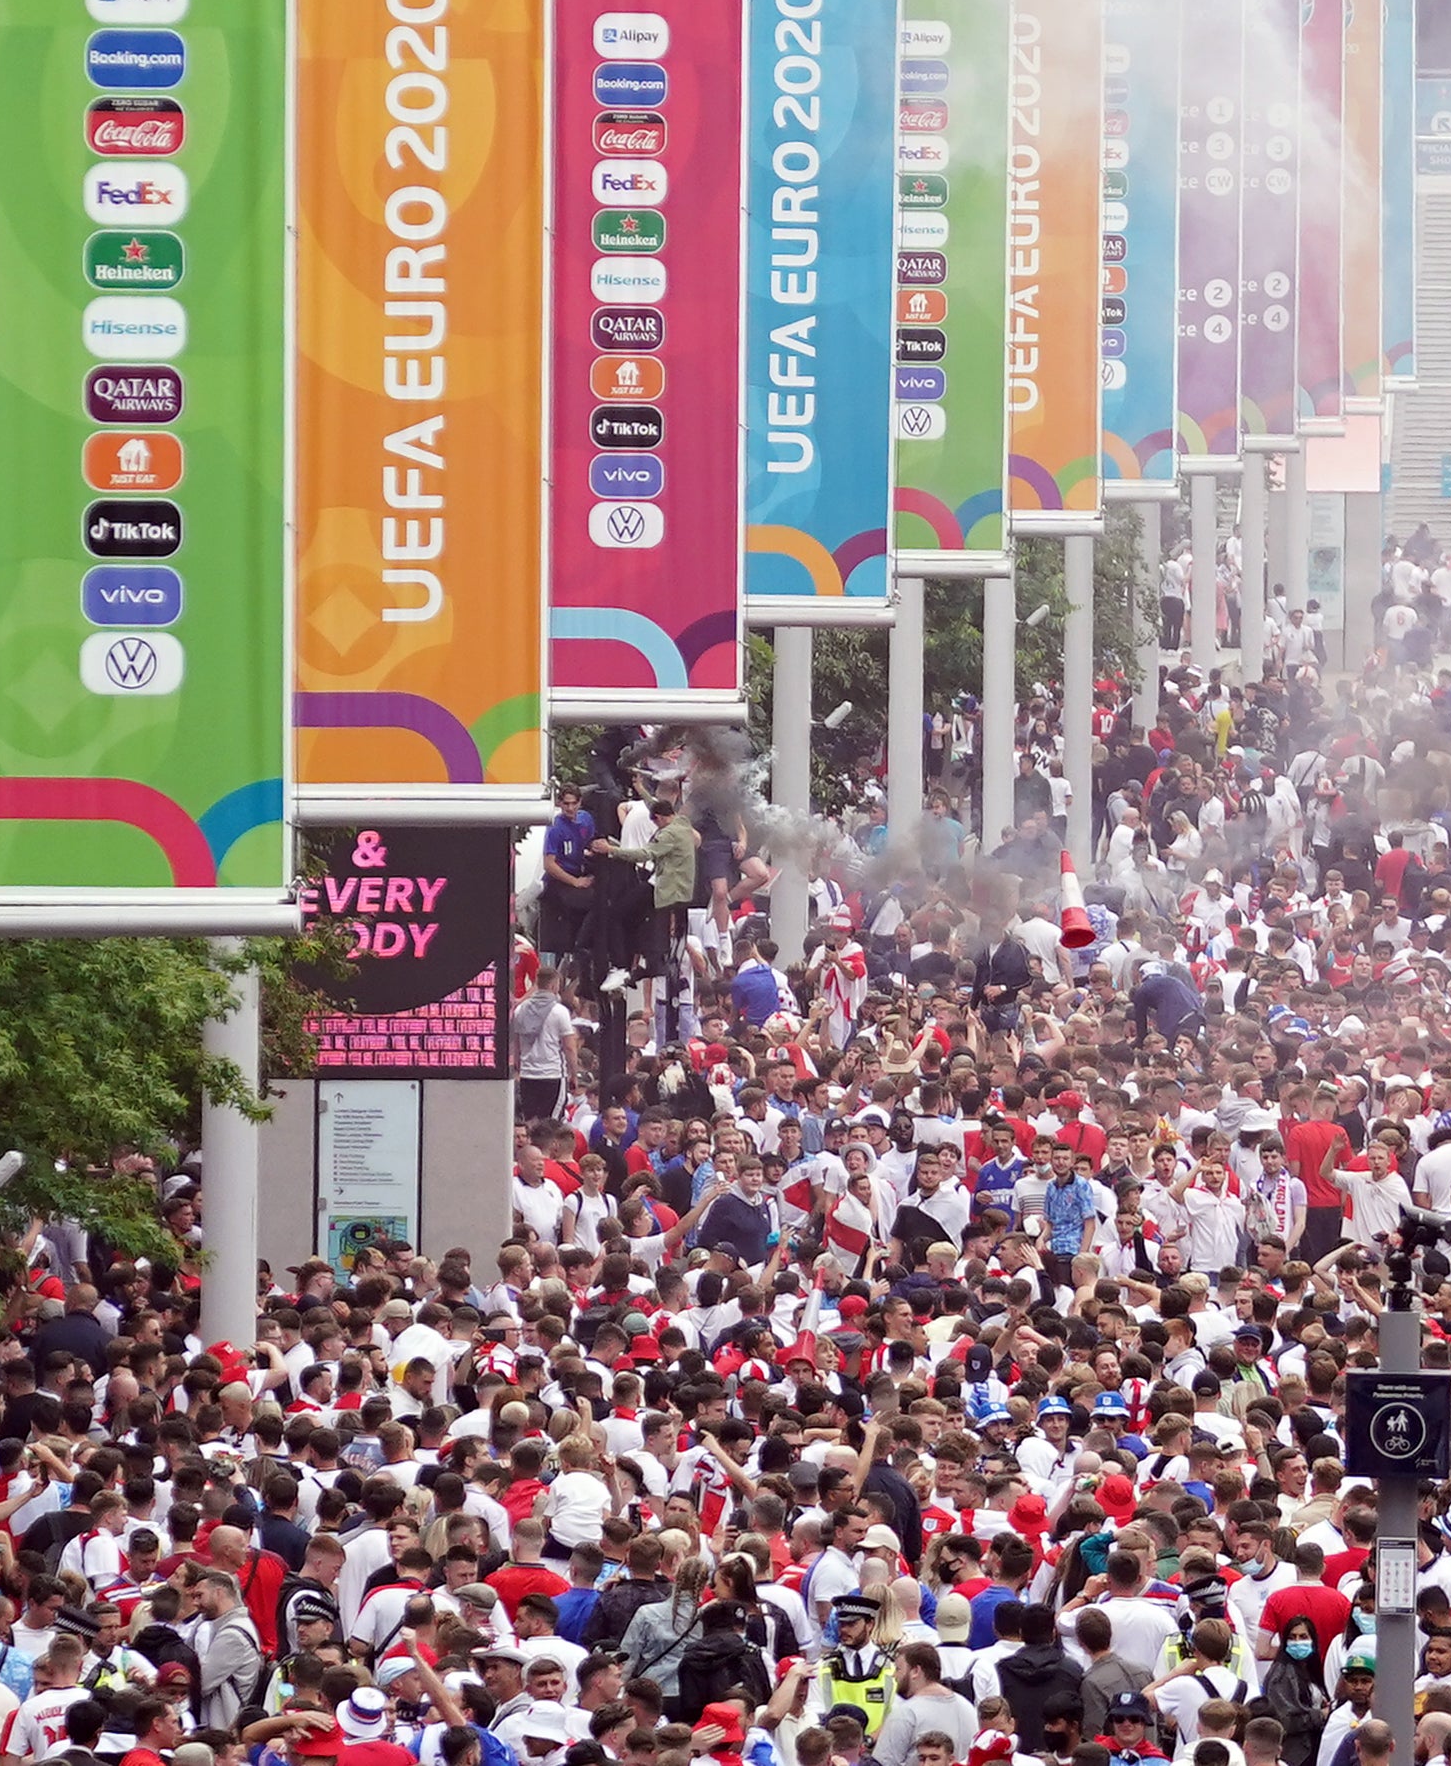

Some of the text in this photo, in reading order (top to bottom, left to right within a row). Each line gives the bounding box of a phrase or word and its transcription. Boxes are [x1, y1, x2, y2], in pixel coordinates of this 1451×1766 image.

[620, 29, 659, 43] Alipay
[913, 33, 944, 43] Alipay
[90, 49, 181, 68] Booking.com
[597, 78, 664, 92] Booking.com
[1214, 139, 1225, 152] 3
[1274, 142, 1283, 155] 3
[899, 146, 941, 160] FedEx
[602, 173, 657, 192] FedEx
[1207, 175, 1232, 188] CW
[97, 181, 172, 205] FedEx
[770, 141, 821, 305] EURO
[600, 233, 658, 246] Heineken
[897, 258, 941, 272] QATAR
[95, 264, 174, 281] Heineken
[596, 273, 661, 287] Hisense
[1271, 279, 1282, 292] 2
[384, 186, 449, 401] EURO
[1213, 287, 1223, 301] 2
[598, 317, 657, 334] QATAR
[1271, 312, 1281, 325] 4
[90, 319, 178, 336] Hisense
[1212, 323, 1223, 336] 4
[612, 331, 657, 342] AIRWAYS
[906, 340, 943, 352] TikTok
[93, 378, 175, 401] QATAR
[900, 376, 936, 389] vivo
[610, 386, 645, 395] JUST EAT
[767, 315, 818, 474] UEFA
[112, 397, 175, 413] AIRWAYS
[612, 422, 658, 436] TikTok
[110, 474, 157, 485] JUST EAT
[603, 467, 650, 483] vivo
[382, 414, 446, 623] UEFA
[110, 522, 176, 540] TikTok
[100, 585, 166, 604] vivo
[1100, 715, 1114, 734] 10
[351, 830, 388, 869] &
[563, 841, 573, 856] 11
